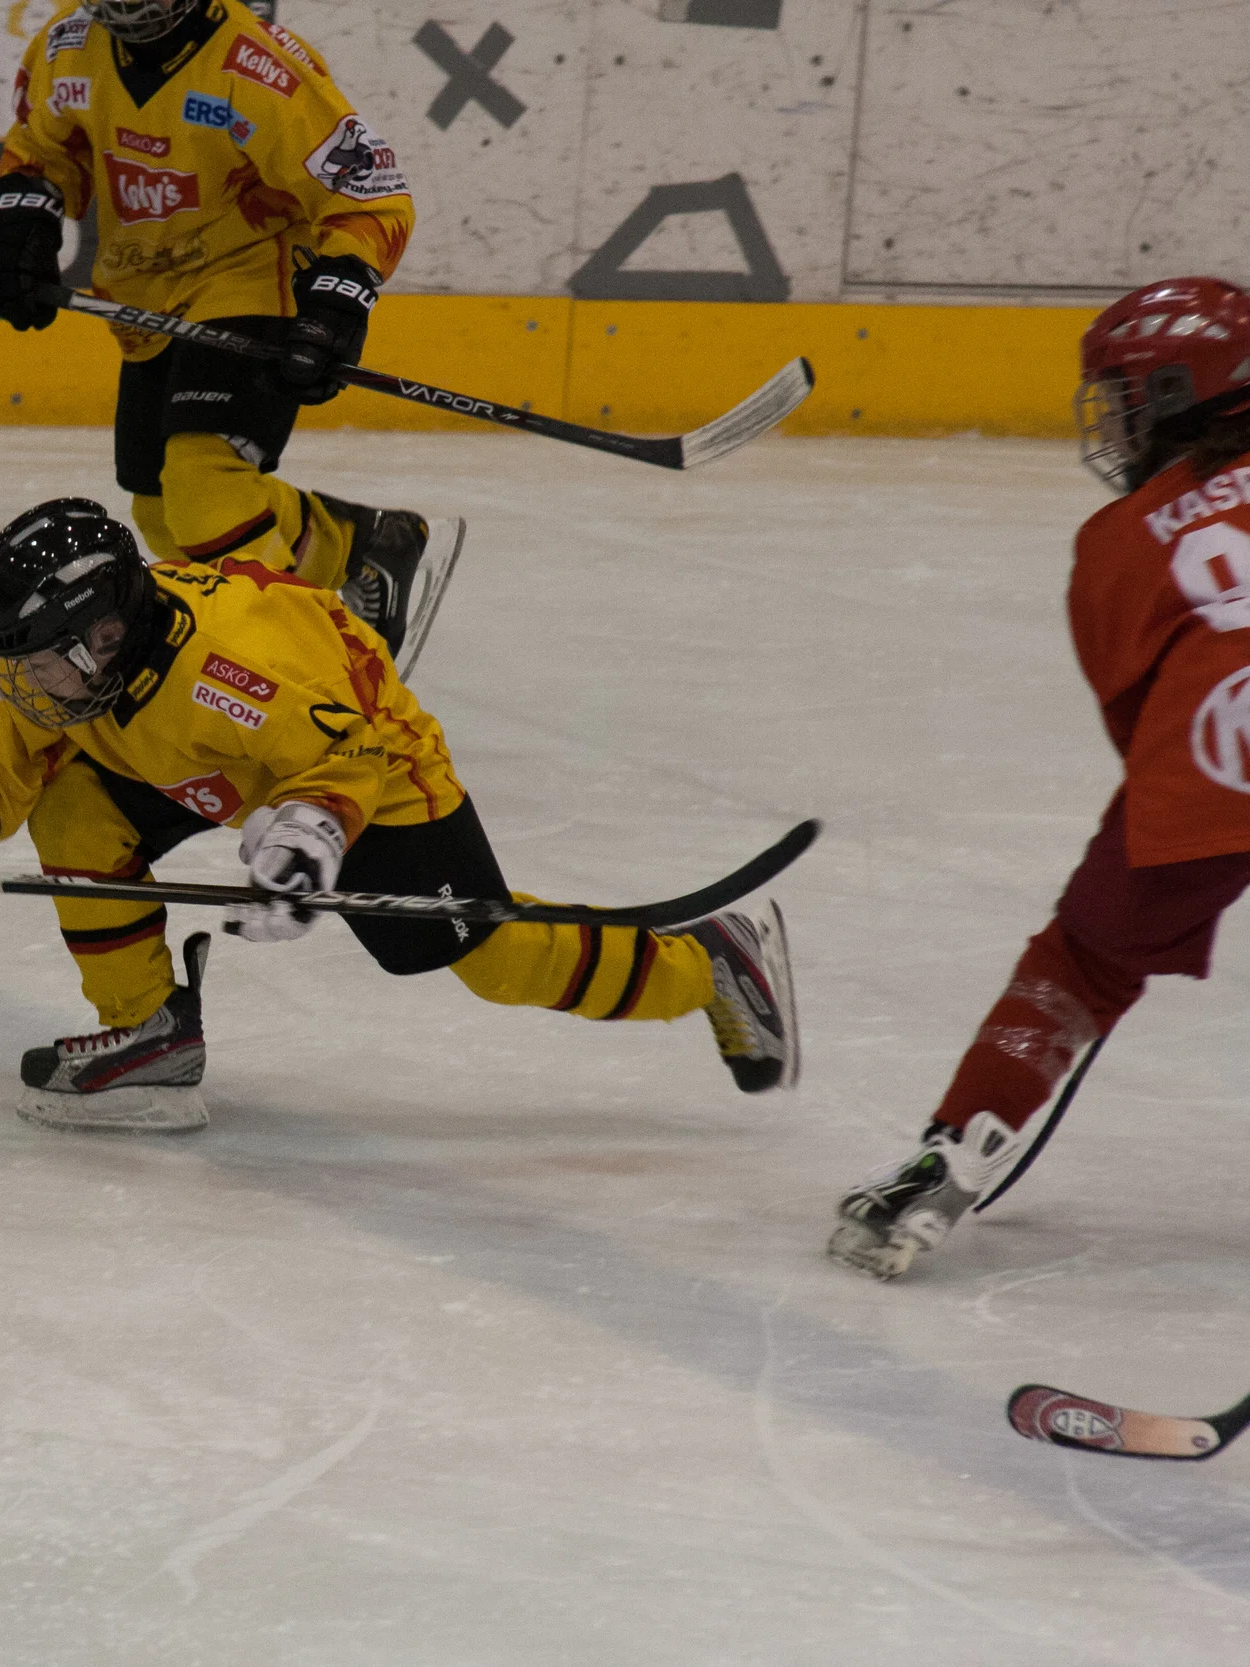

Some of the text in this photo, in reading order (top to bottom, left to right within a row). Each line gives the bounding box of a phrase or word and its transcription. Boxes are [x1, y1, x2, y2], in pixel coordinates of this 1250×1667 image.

[236, 44, 291, 88] Kelly's
[397, 377, 497, 422] VAPOR
[63, 587, 95, 611] Reebok
[207, 660, 250, 687] ASKÖ
[196, 686, 262, 727] RICOH
[438, 883, 471, 943] Rok
